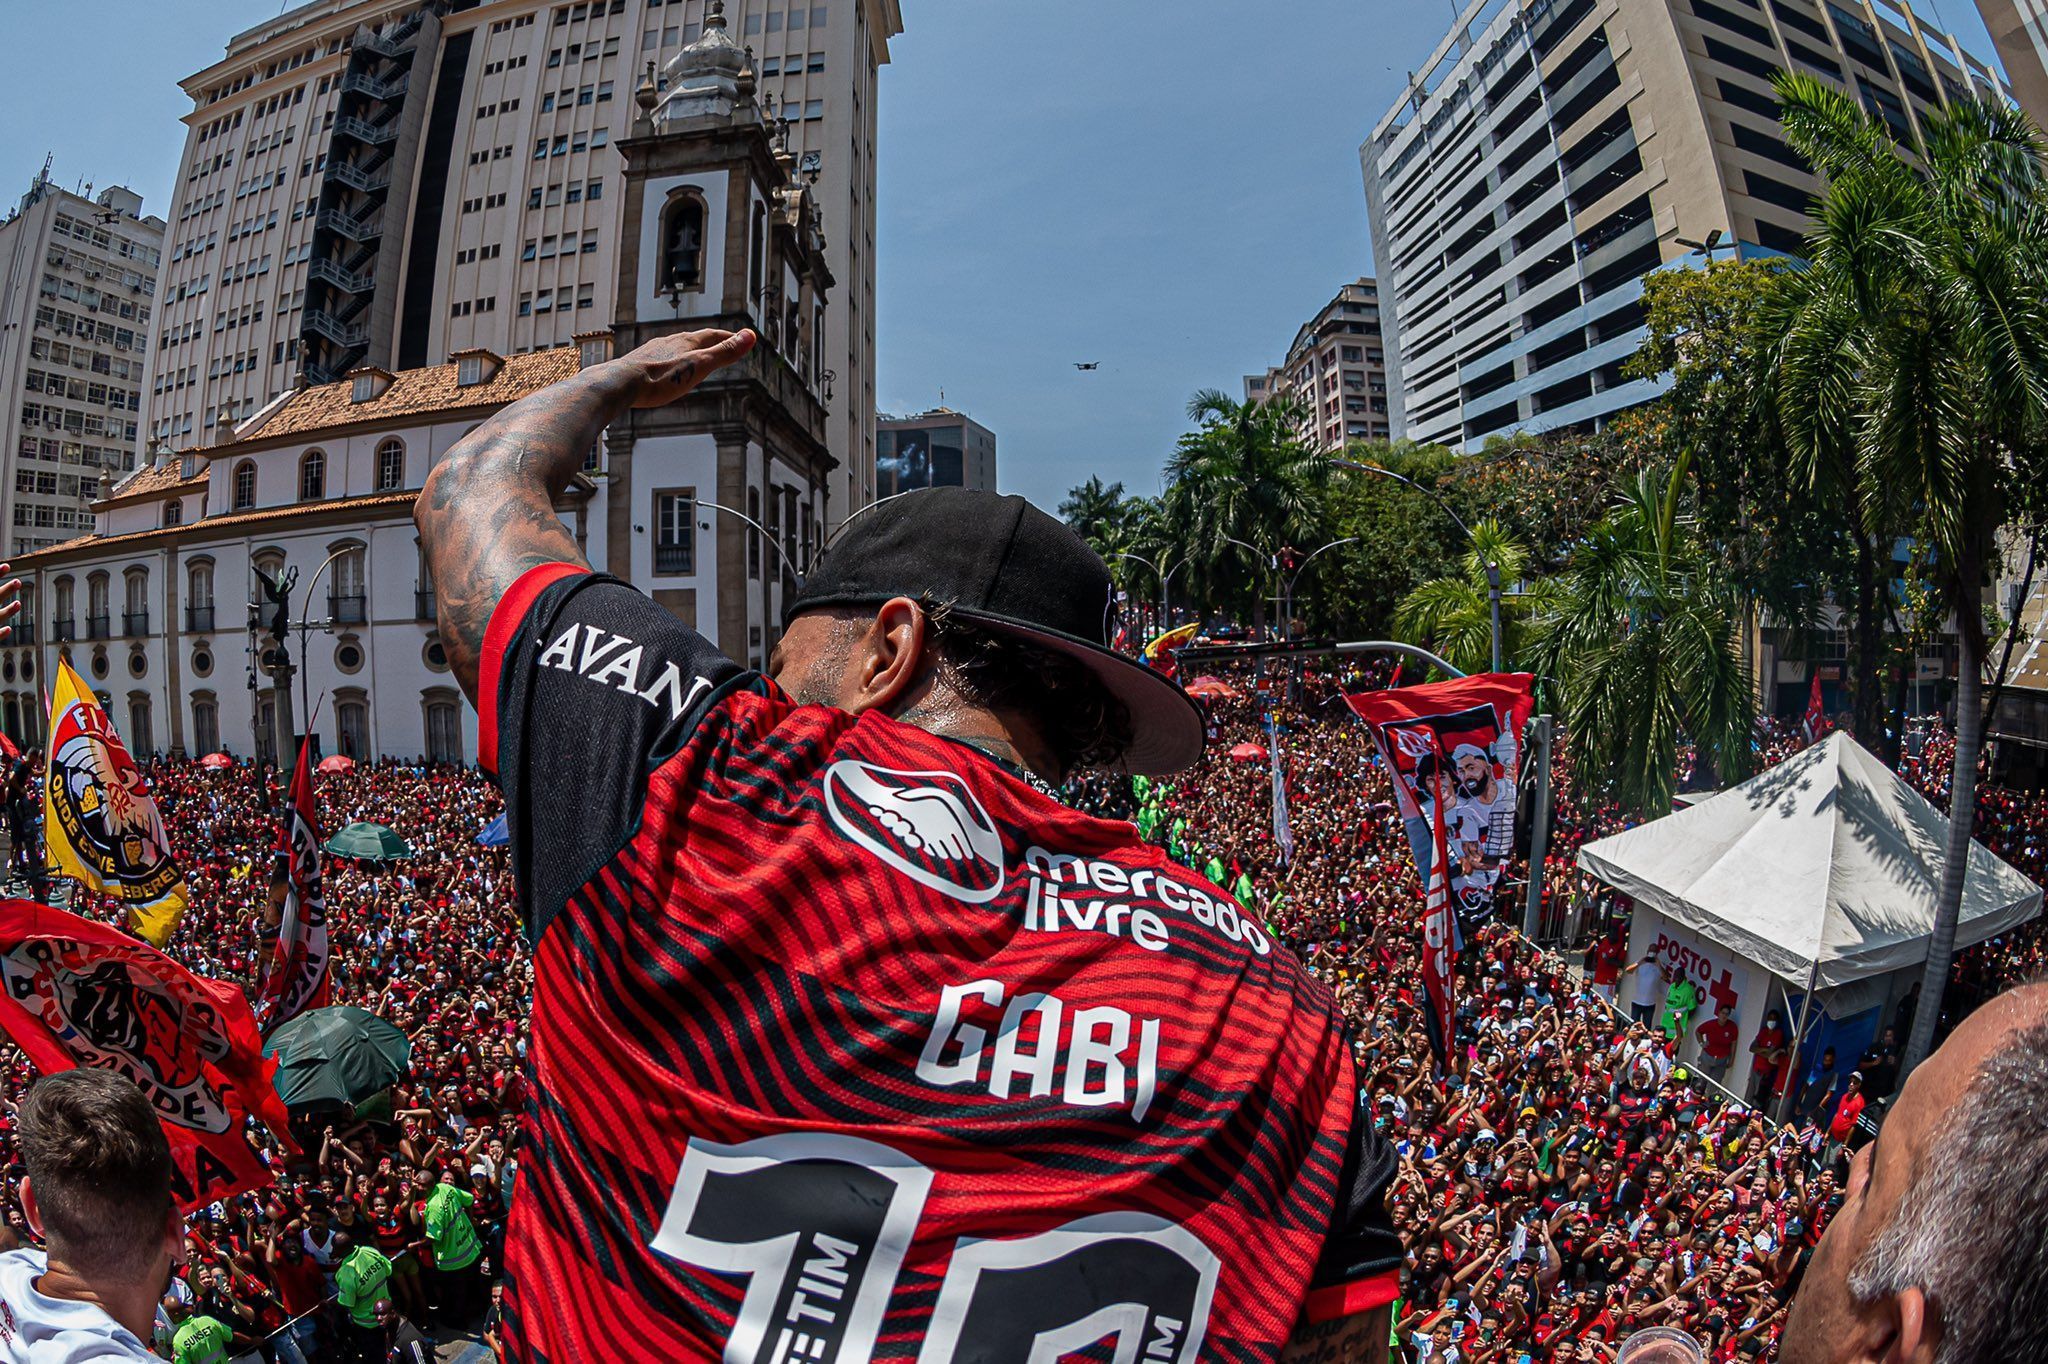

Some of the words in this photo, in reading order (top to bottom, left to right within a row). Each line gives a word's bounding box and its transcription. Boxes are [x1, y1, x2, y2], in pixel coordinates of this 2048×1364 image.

[537, 622, 714, 721] AVAN
[52, 773, 78, 837] ONDE
[122, 865, 179, 899] EBEREI
[1024, 877, 1169, 951] livre
[1025, 845, 1270, 955] mercado
[1657, 932, 1712, 982] POSTO
[914, 978, 1161, 1123] GABI
[786, 1232, 859, 1324] TIM
[183, 1325, 214, 1350] SUNSET
